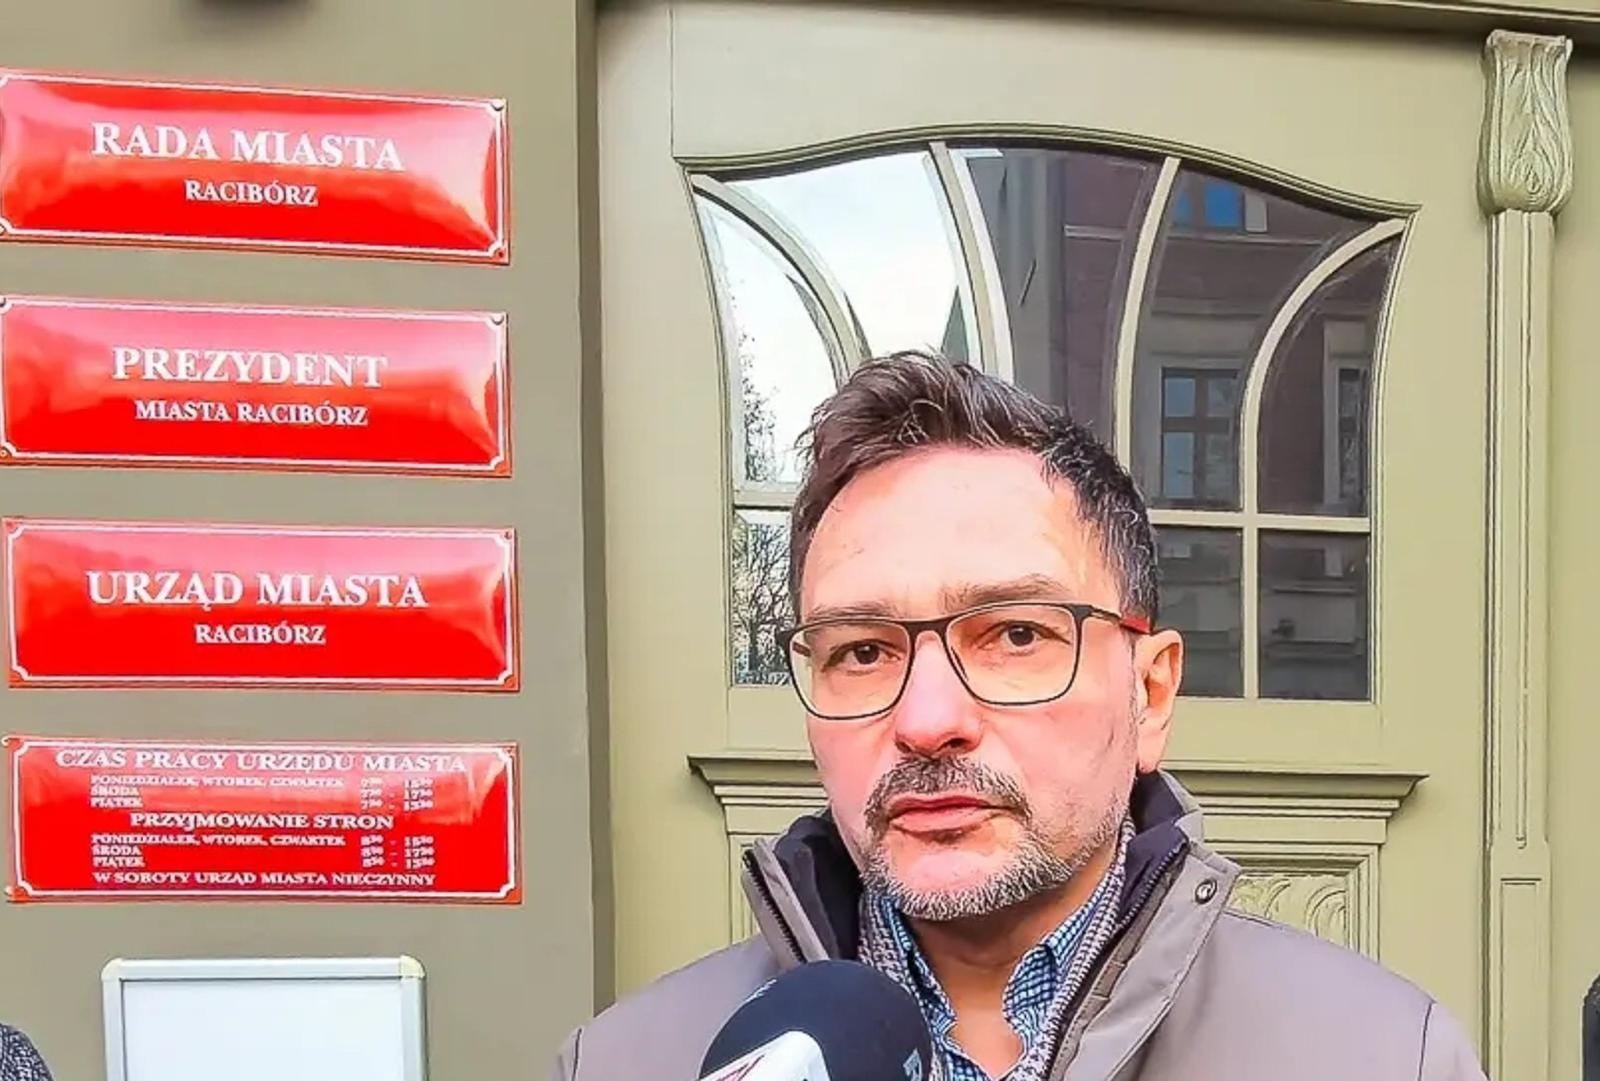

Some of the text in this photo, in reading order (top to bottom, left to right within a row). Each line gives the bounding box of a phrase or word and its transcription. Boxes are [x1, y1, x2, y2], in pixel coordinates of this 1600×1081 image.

[92, 122, 404, 171] RADA MIASTA
[185, 179, 318, 207] RACIBÓRZ
[112, 347, 388, 388] PREZYDENT
[136, 400, 368, 426] MIASTA RACIBÓRZ
[86, 570, 428, 612] URZĄD MIASTA
[195, 621, 326, 645] RACIBÓRZ
[55, 749, 127, 768] CZAS
[134, 750, 228, 769] PRACY
[363, 754, 467, 773] MIASTA
[130, 812, 394, 830] PRZYJMOWANIE STRON
[270, 835, 346, 846] CZWARTEK
[93, 872, 436, 886] W SOBOTY URZĄD MIASTA NIECZYNNY
